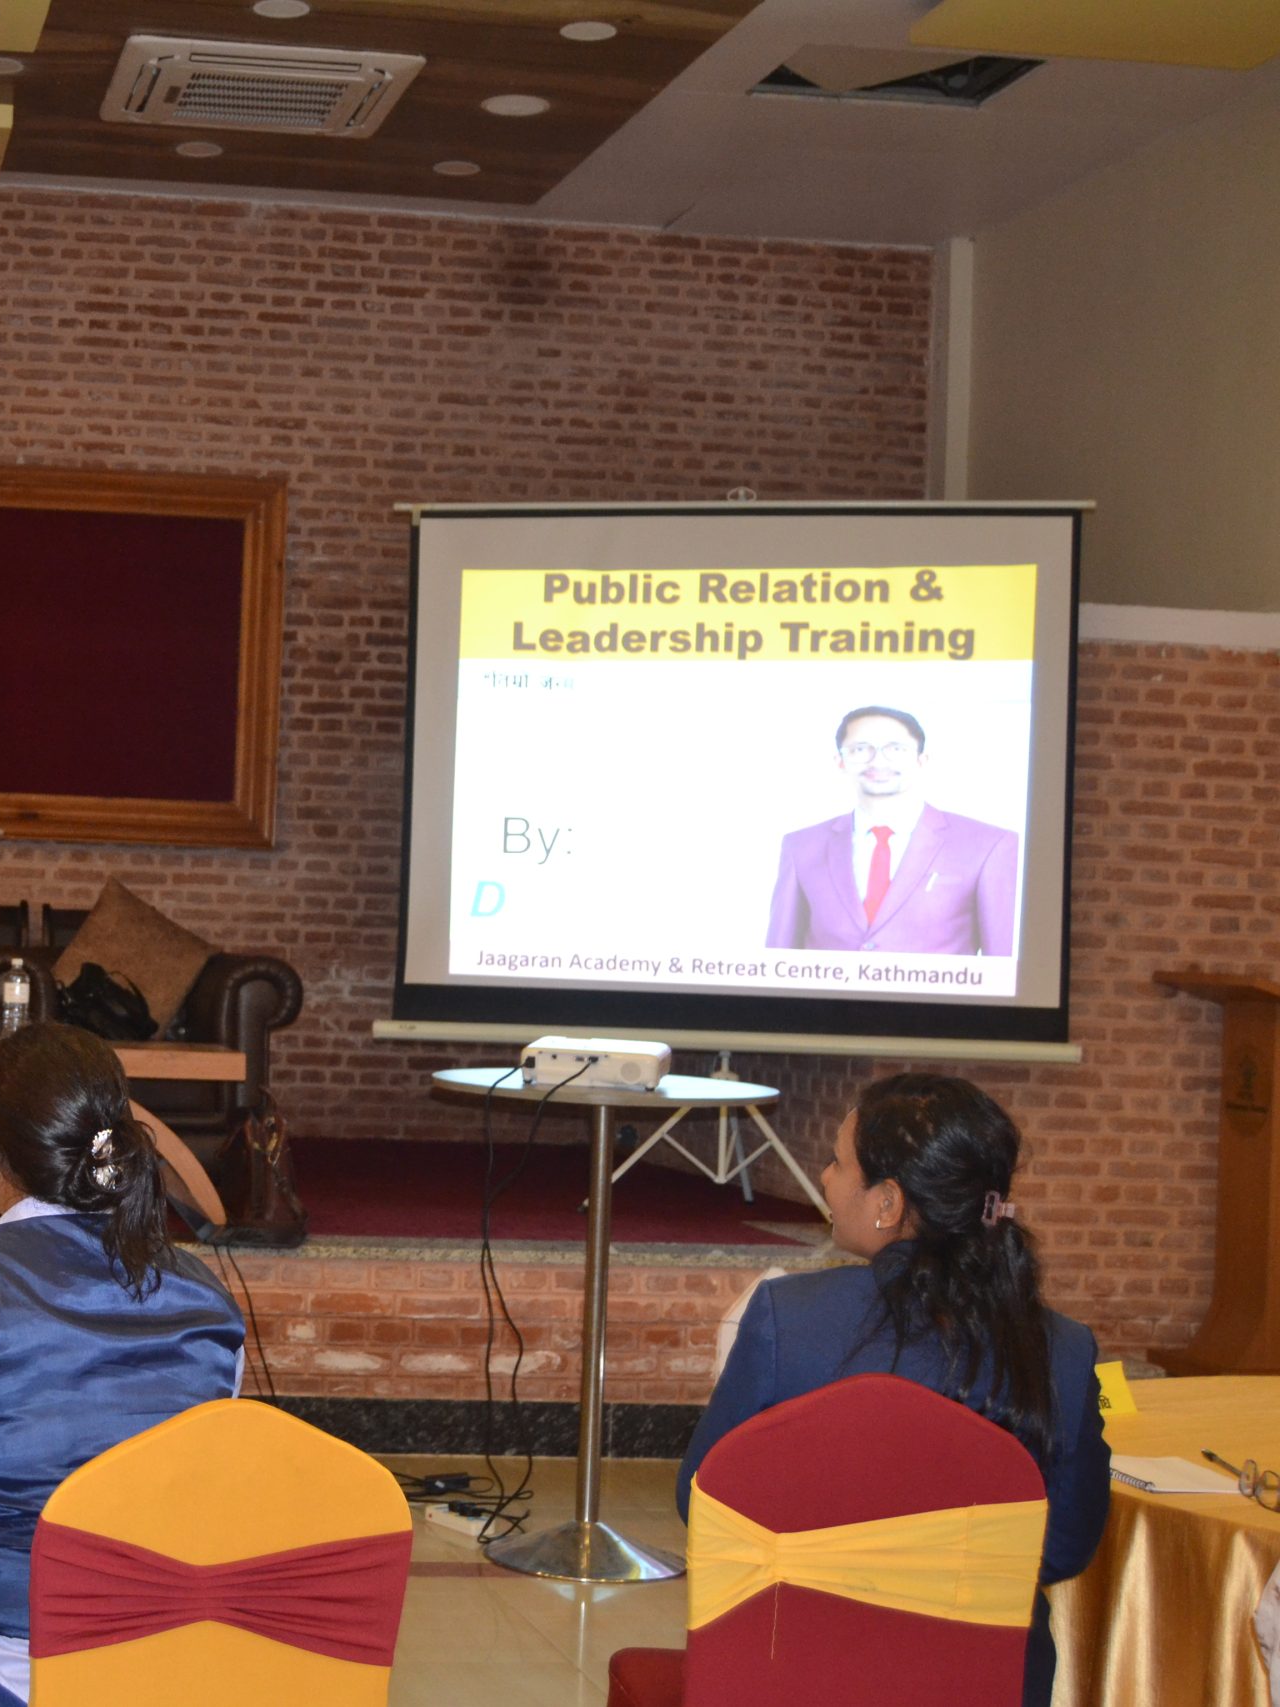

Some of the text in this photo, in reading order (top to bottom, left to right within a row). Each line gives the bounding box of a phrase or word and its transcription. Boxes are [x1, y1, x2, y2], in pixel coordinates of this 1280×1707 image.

[544, 569, 944, 604] Public Relation &
[513, 621, 975, 661] Leadership Training
[503, 816, 572, 865] By:
[477, 950, 983, 986] Jaagaran Academy & Retreat Centre, Kathmandu
